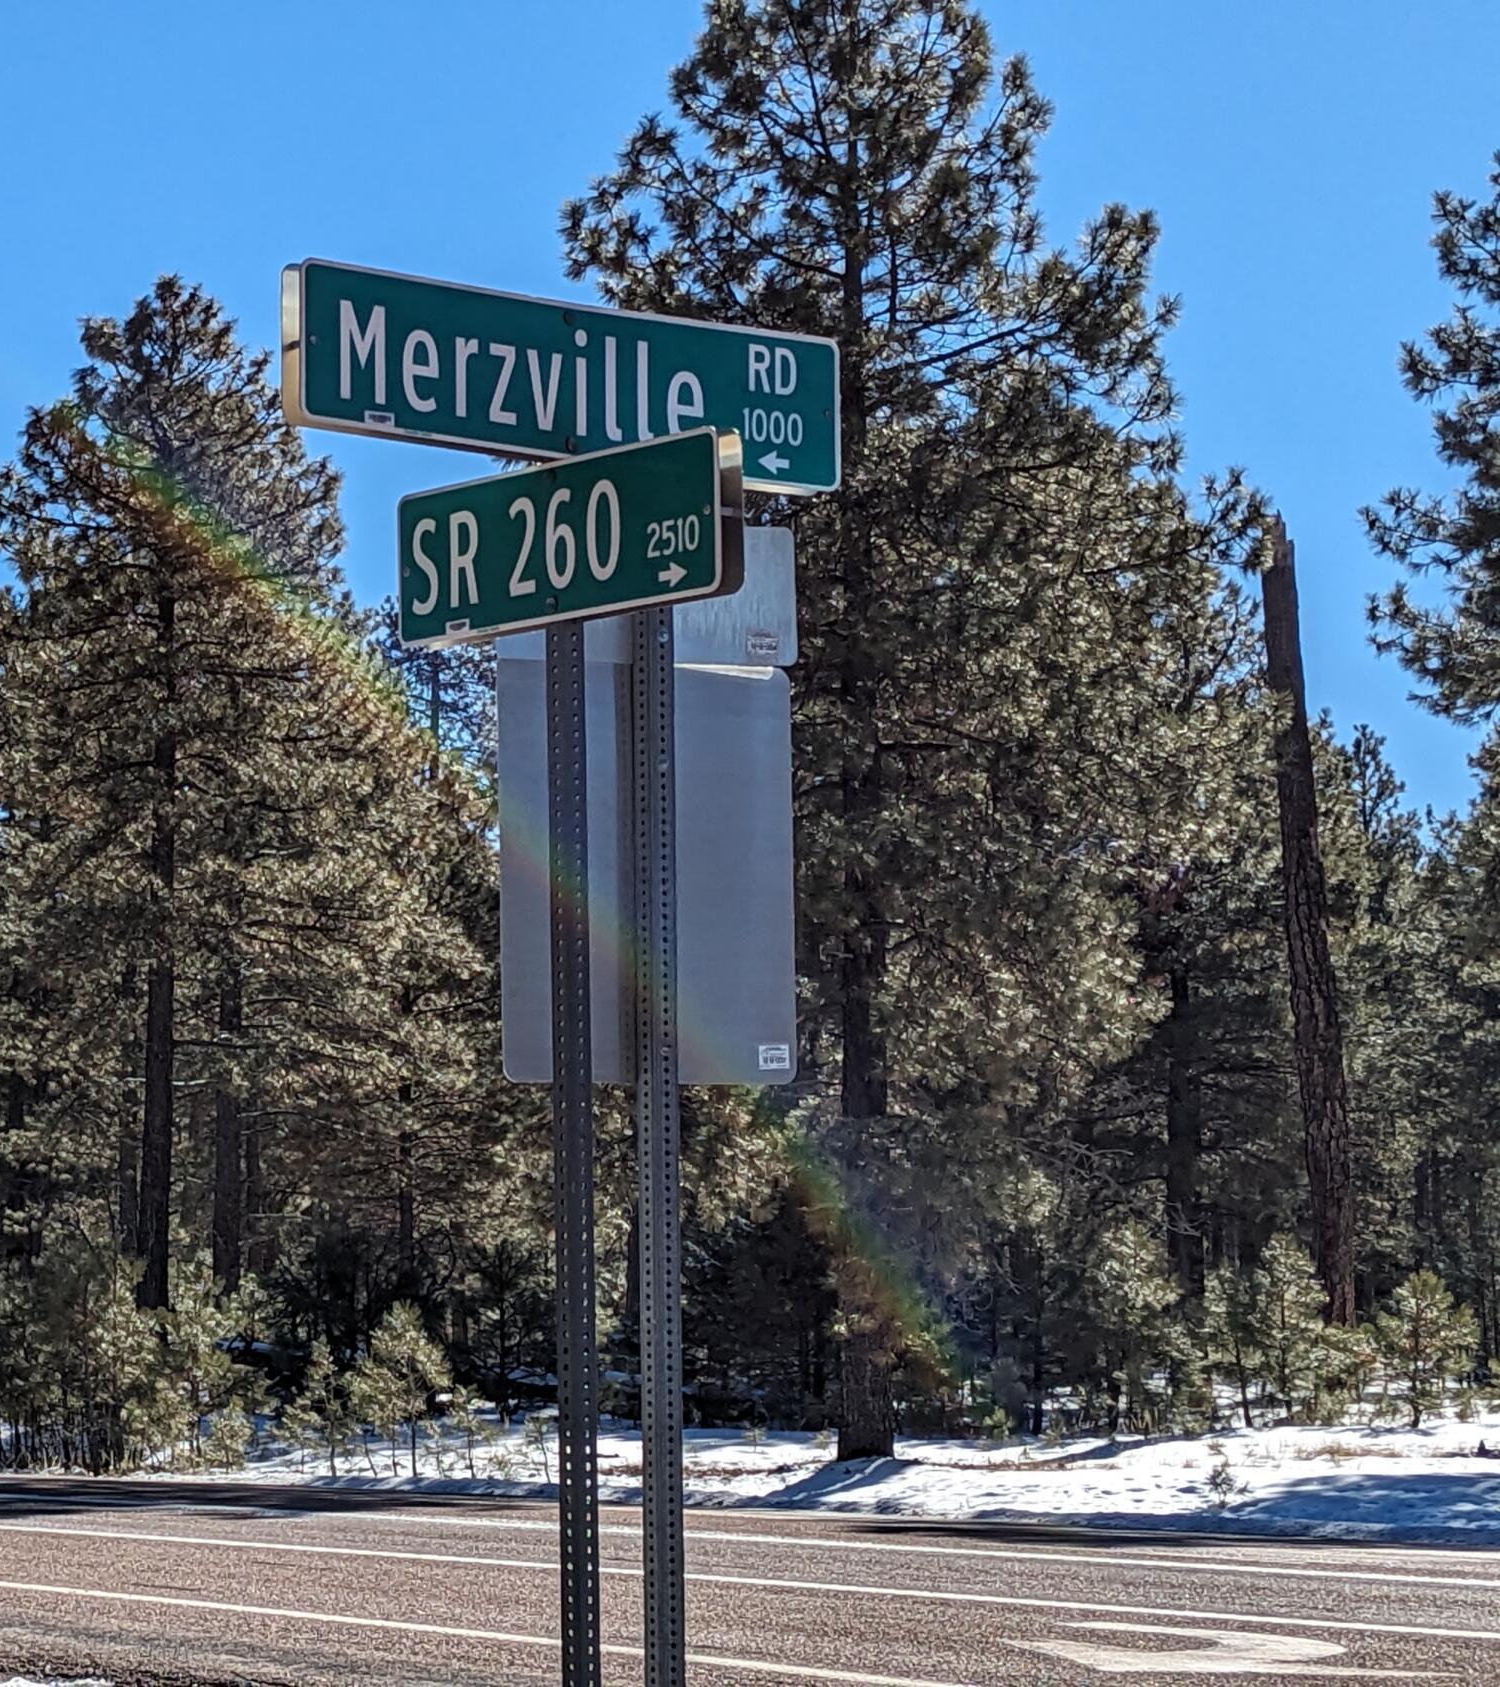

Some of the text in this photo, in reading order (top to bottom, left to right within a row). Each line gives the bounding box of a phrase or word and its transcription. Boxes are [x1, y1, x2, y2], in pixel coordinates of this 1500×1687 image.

[338, 299, 798, 442] Merzville RD
[742, 407, 803, 447] 1000
[411, 478, 700, 617] SR 260 2510
